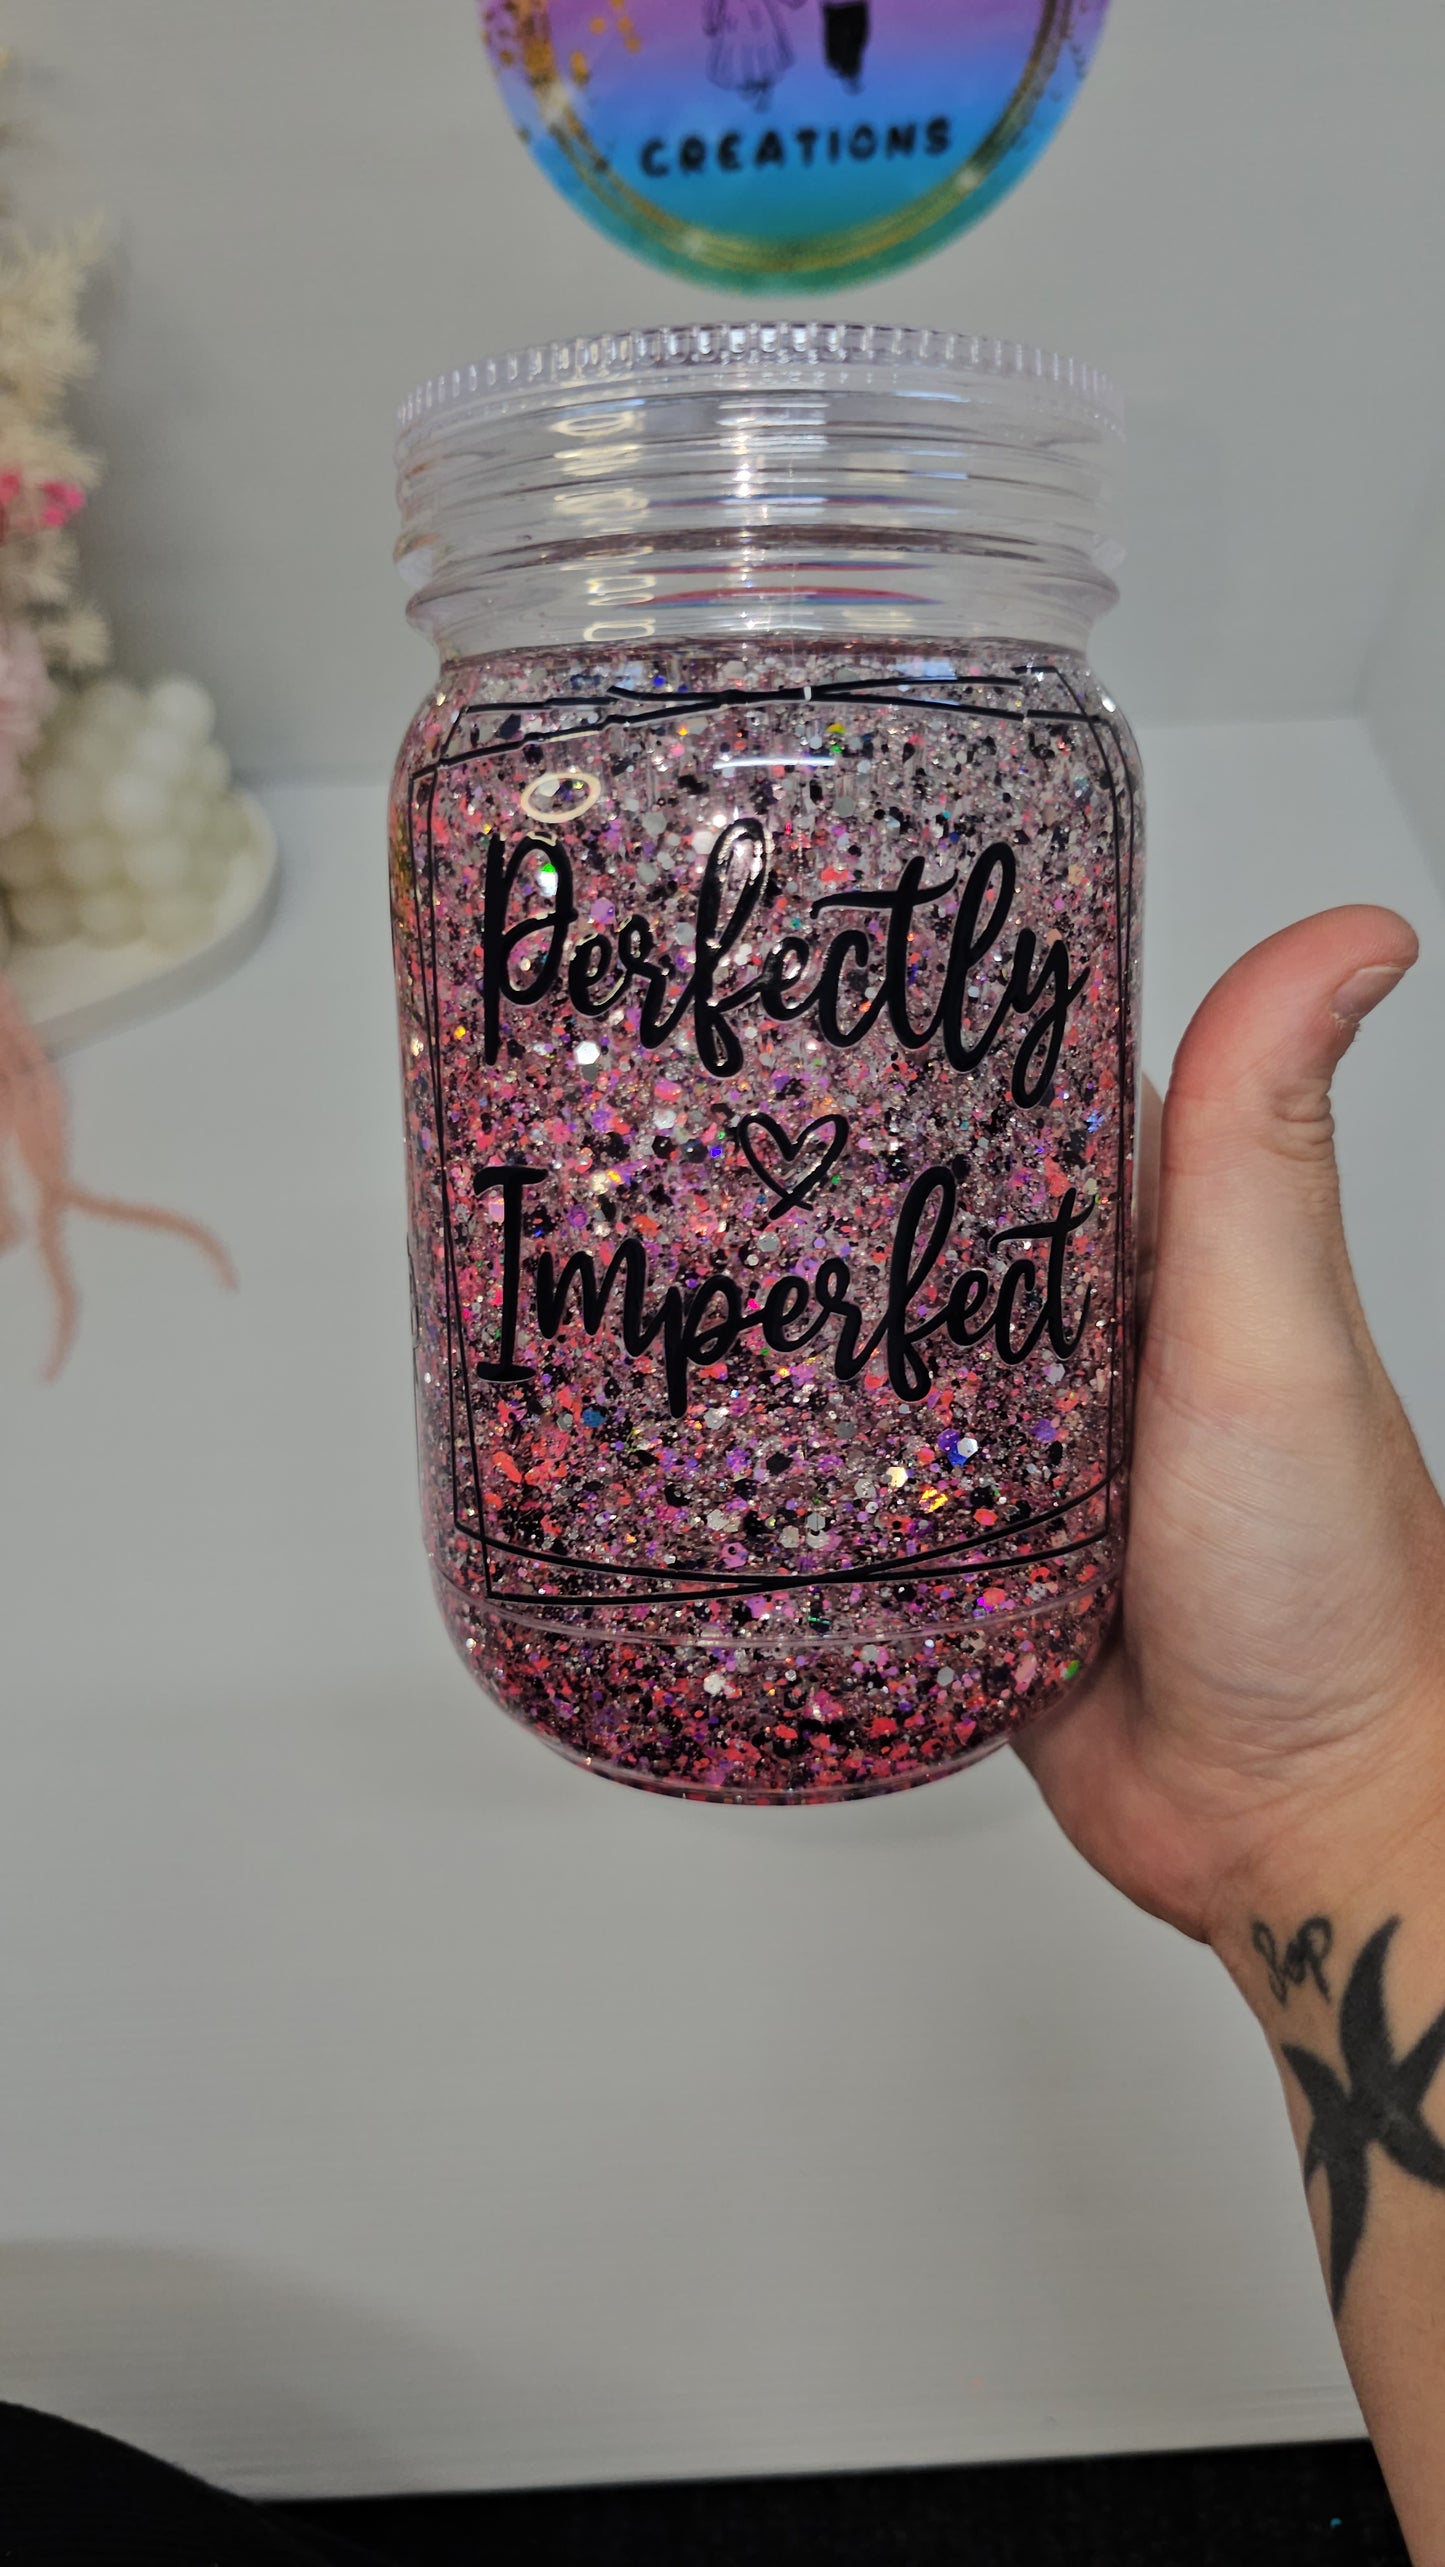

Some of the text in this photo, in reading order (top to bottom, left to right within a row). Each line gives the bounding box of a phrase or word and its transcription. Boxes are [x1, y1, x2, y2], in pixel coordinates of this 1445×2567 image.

[640, 116, 951, 177] CREATIONS
[483, 817, 1090, 1109] Perfectly
[473, 1166, 1094, 1418] Imperfect
